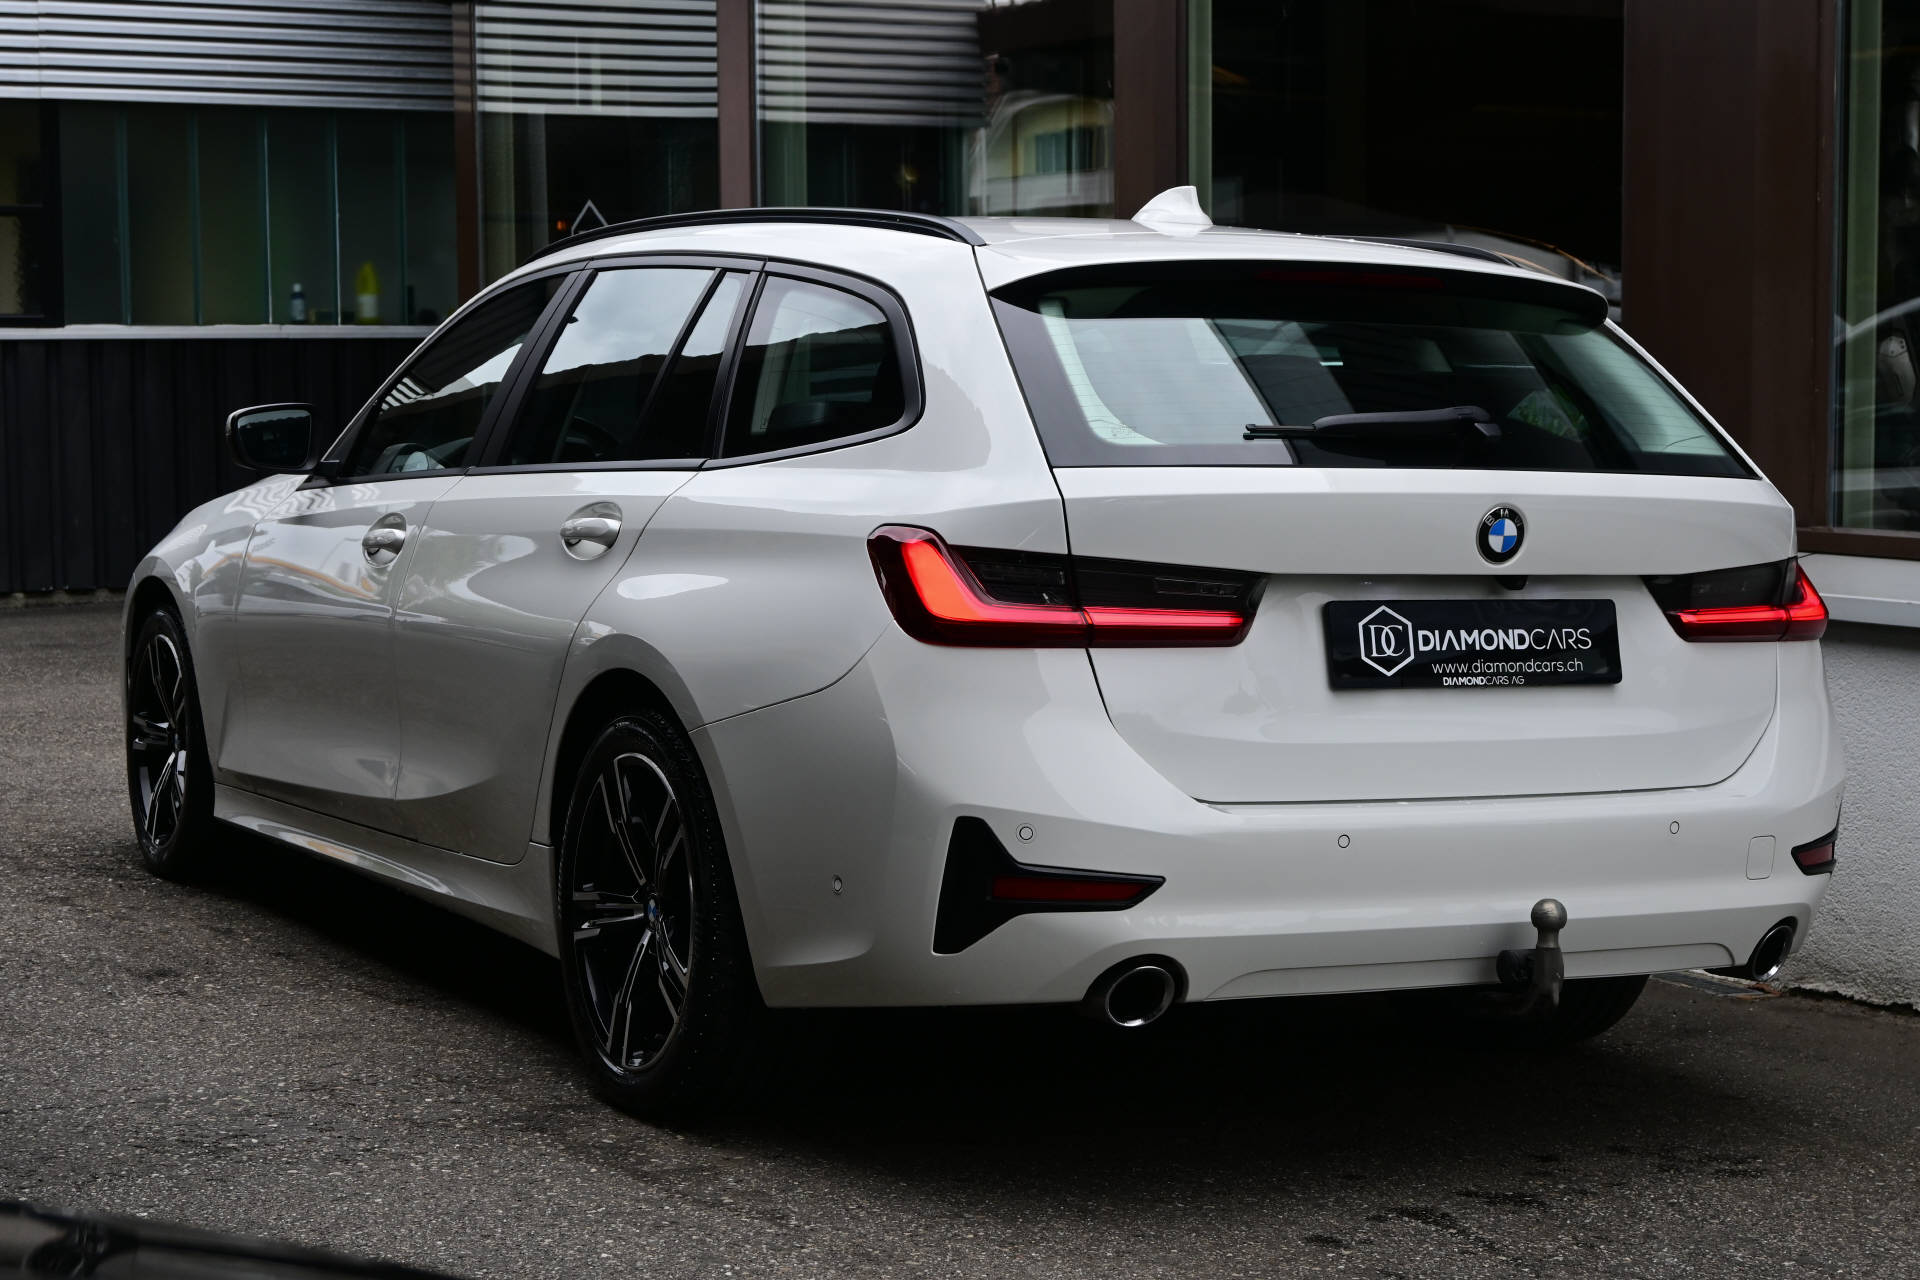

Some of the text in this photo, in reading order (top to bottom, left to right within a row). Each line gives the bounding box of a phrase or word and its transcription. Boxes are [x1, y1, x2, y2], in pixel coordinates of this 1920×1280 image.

[1368, 625, 1405, 657] DC
[1417, 628, 1592, 652] DIAMONDCARS
[1431, 658, 1584, 674] www.diamondcars.ch
[1442, 675, 1525, 686] DIAMONDCARS AG
